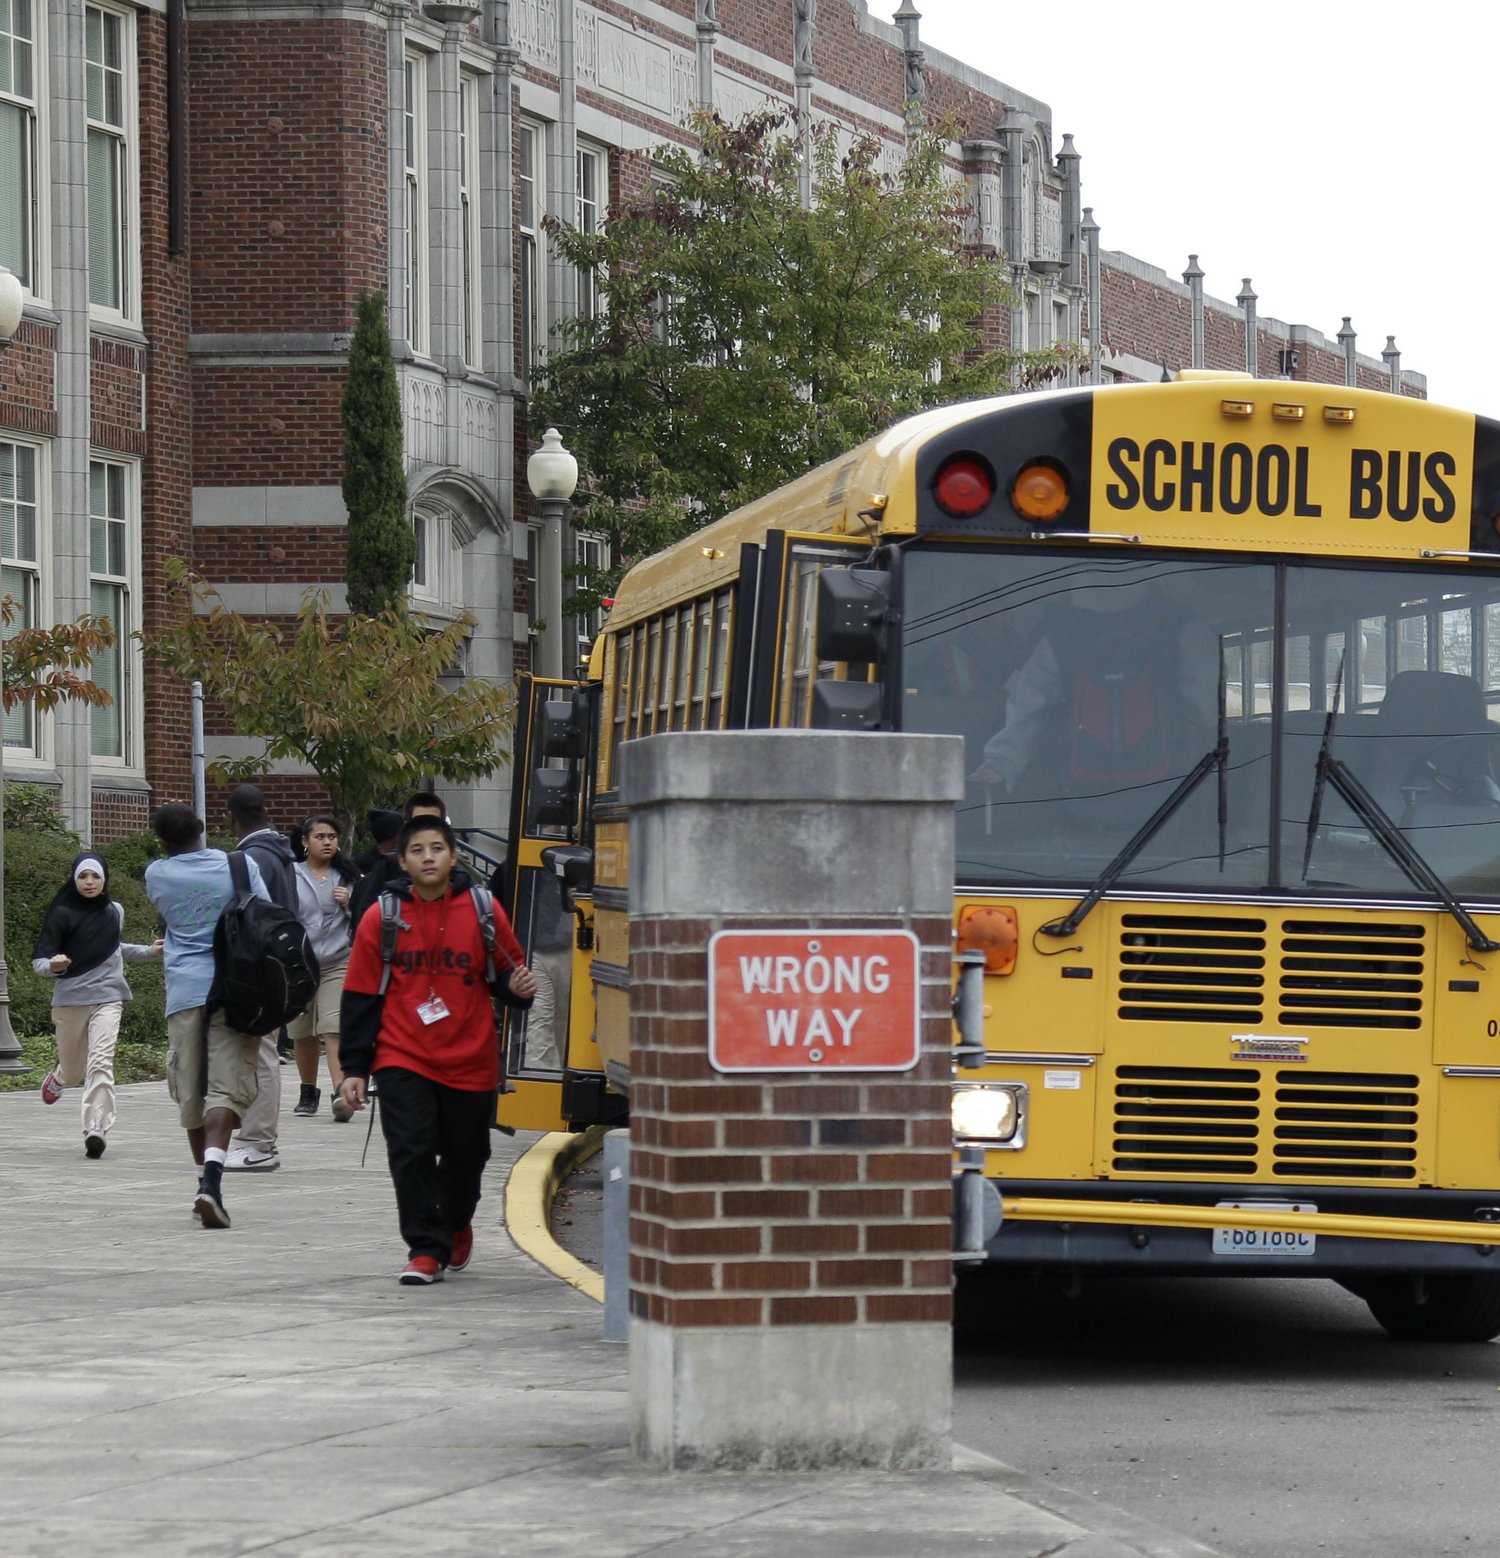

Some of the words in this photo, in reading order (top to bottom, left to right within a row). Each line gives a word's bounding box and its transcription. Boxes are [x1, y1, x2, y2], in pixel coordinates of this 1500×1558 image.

[1105, 436, 1322, 518] SCHOOL
[1349, 448, 1457, 524] BUS
[739, 954, 891, 995] WRONG
[766, 1008, 863, 1047] WAY
